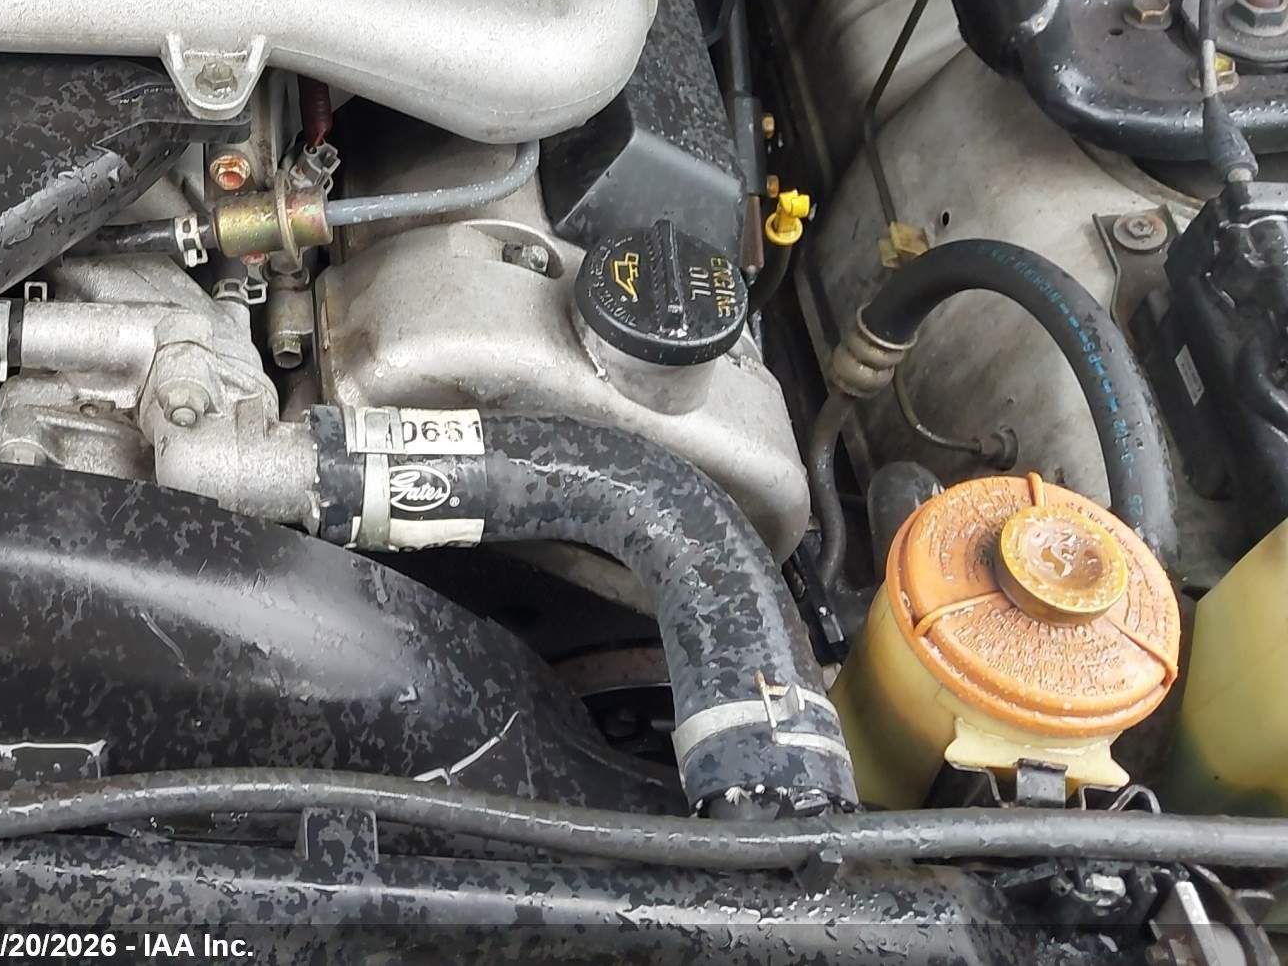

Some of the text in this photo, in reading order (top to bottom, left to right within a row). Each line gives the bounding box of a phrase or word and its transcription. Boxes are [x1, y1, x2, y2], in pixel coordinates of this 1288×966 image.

[688, 266, 711, 301] OIL
[710, 257, 737, 319] ENGINE
[390, 471, 446, 501] Gates
